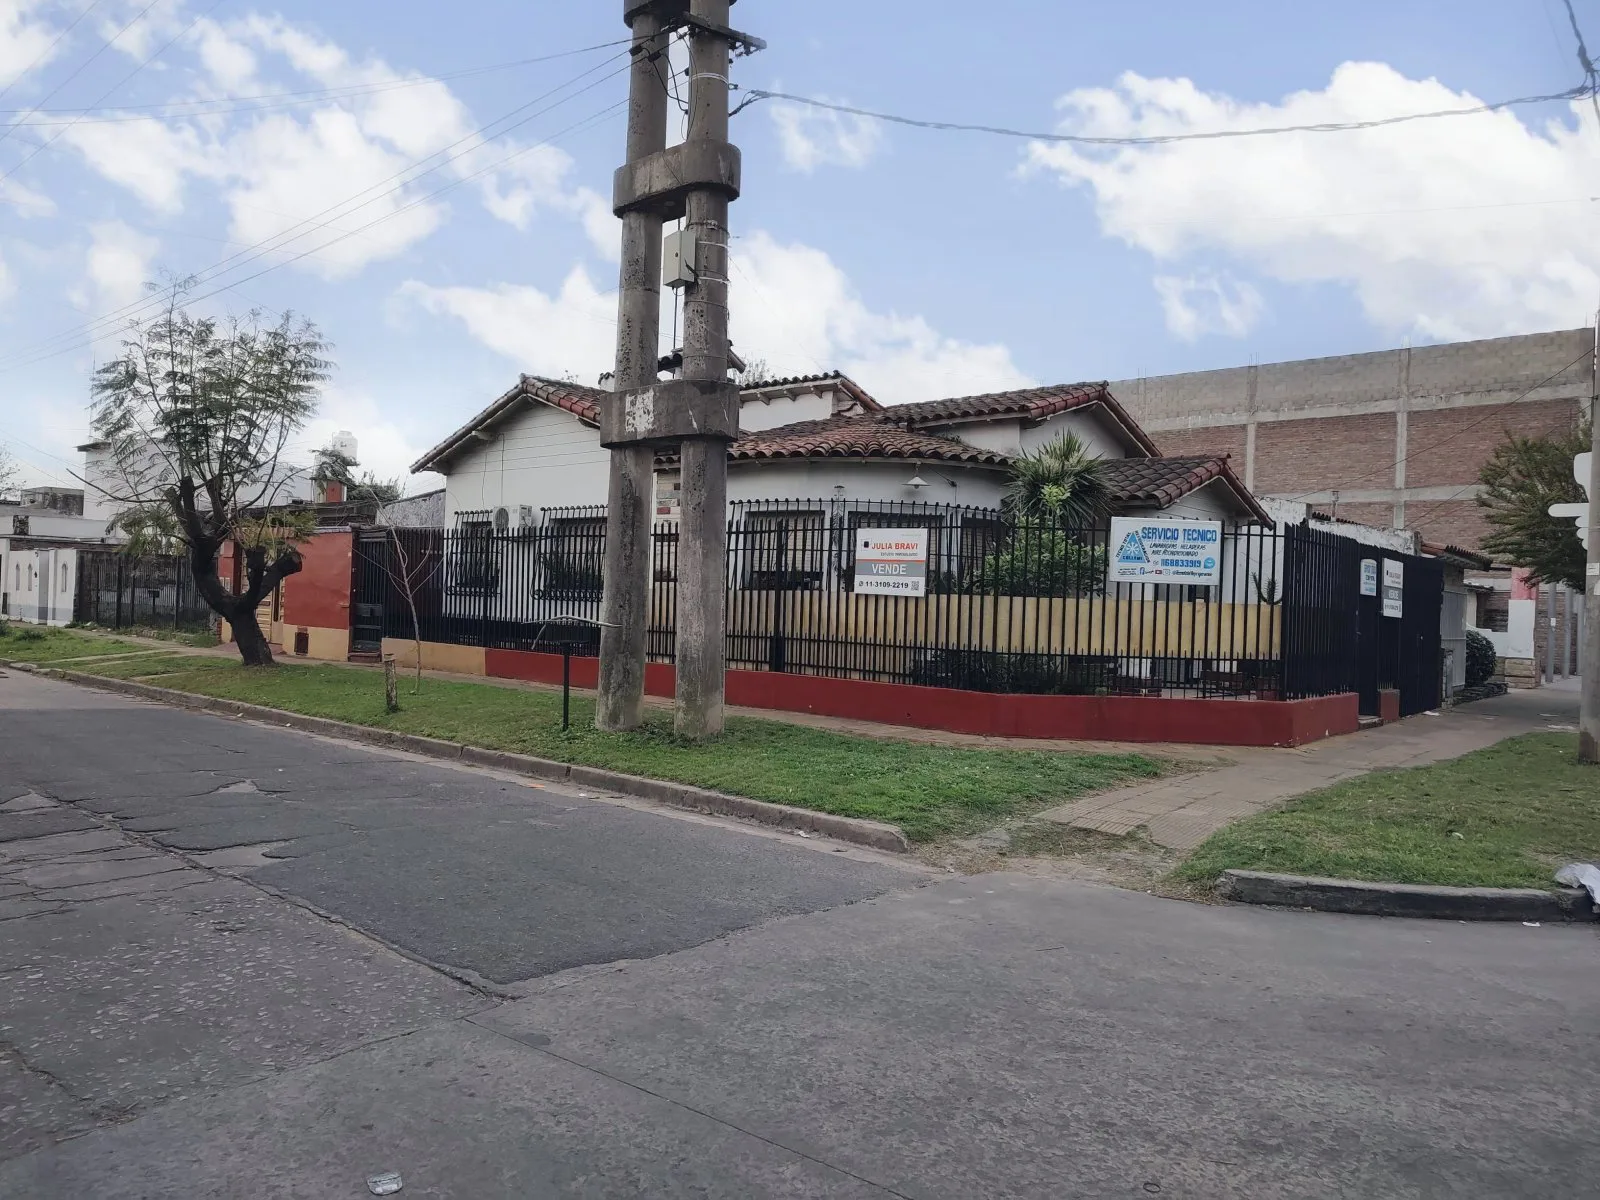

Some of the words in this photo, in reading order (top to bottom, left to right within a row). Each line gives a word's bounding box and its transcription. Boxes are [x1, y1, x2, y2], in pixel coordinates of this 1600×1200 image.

[1141, 526, 1179, 541] SERVICIO
[1183, 528, 1217, 542] TECNICO
[871, 563, 907, 575] VENDE
